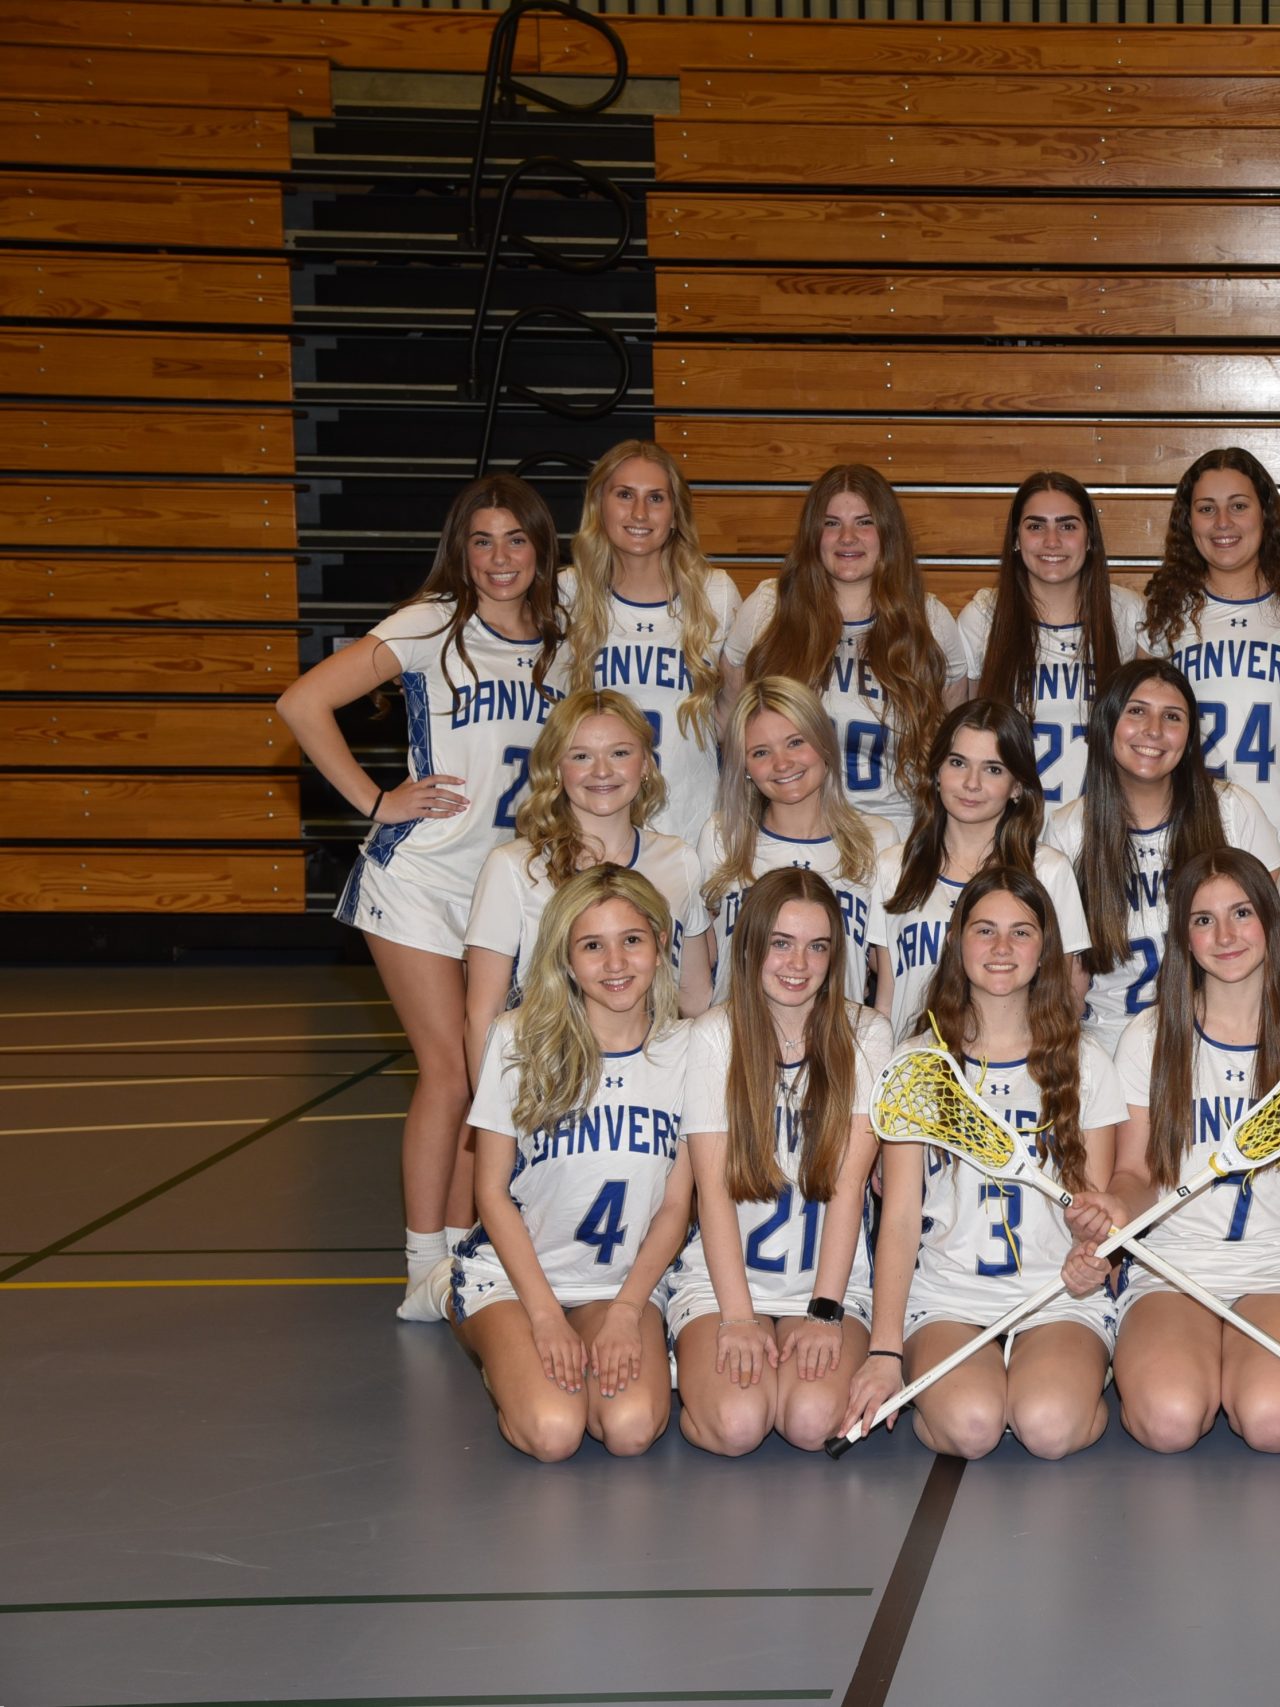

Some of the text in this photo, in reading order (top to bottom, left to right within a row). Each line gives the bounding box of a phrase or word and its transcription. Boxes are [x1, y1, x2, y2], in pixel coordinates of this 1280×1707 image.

[451, 679, 566, 730] DANVE
[1197, 700, 1276, 783] 24
[573, 1178, 630, 1266] 4
[745, 1183, 820, 1275] 21
[975, 1182, 1023, 1277] 3
